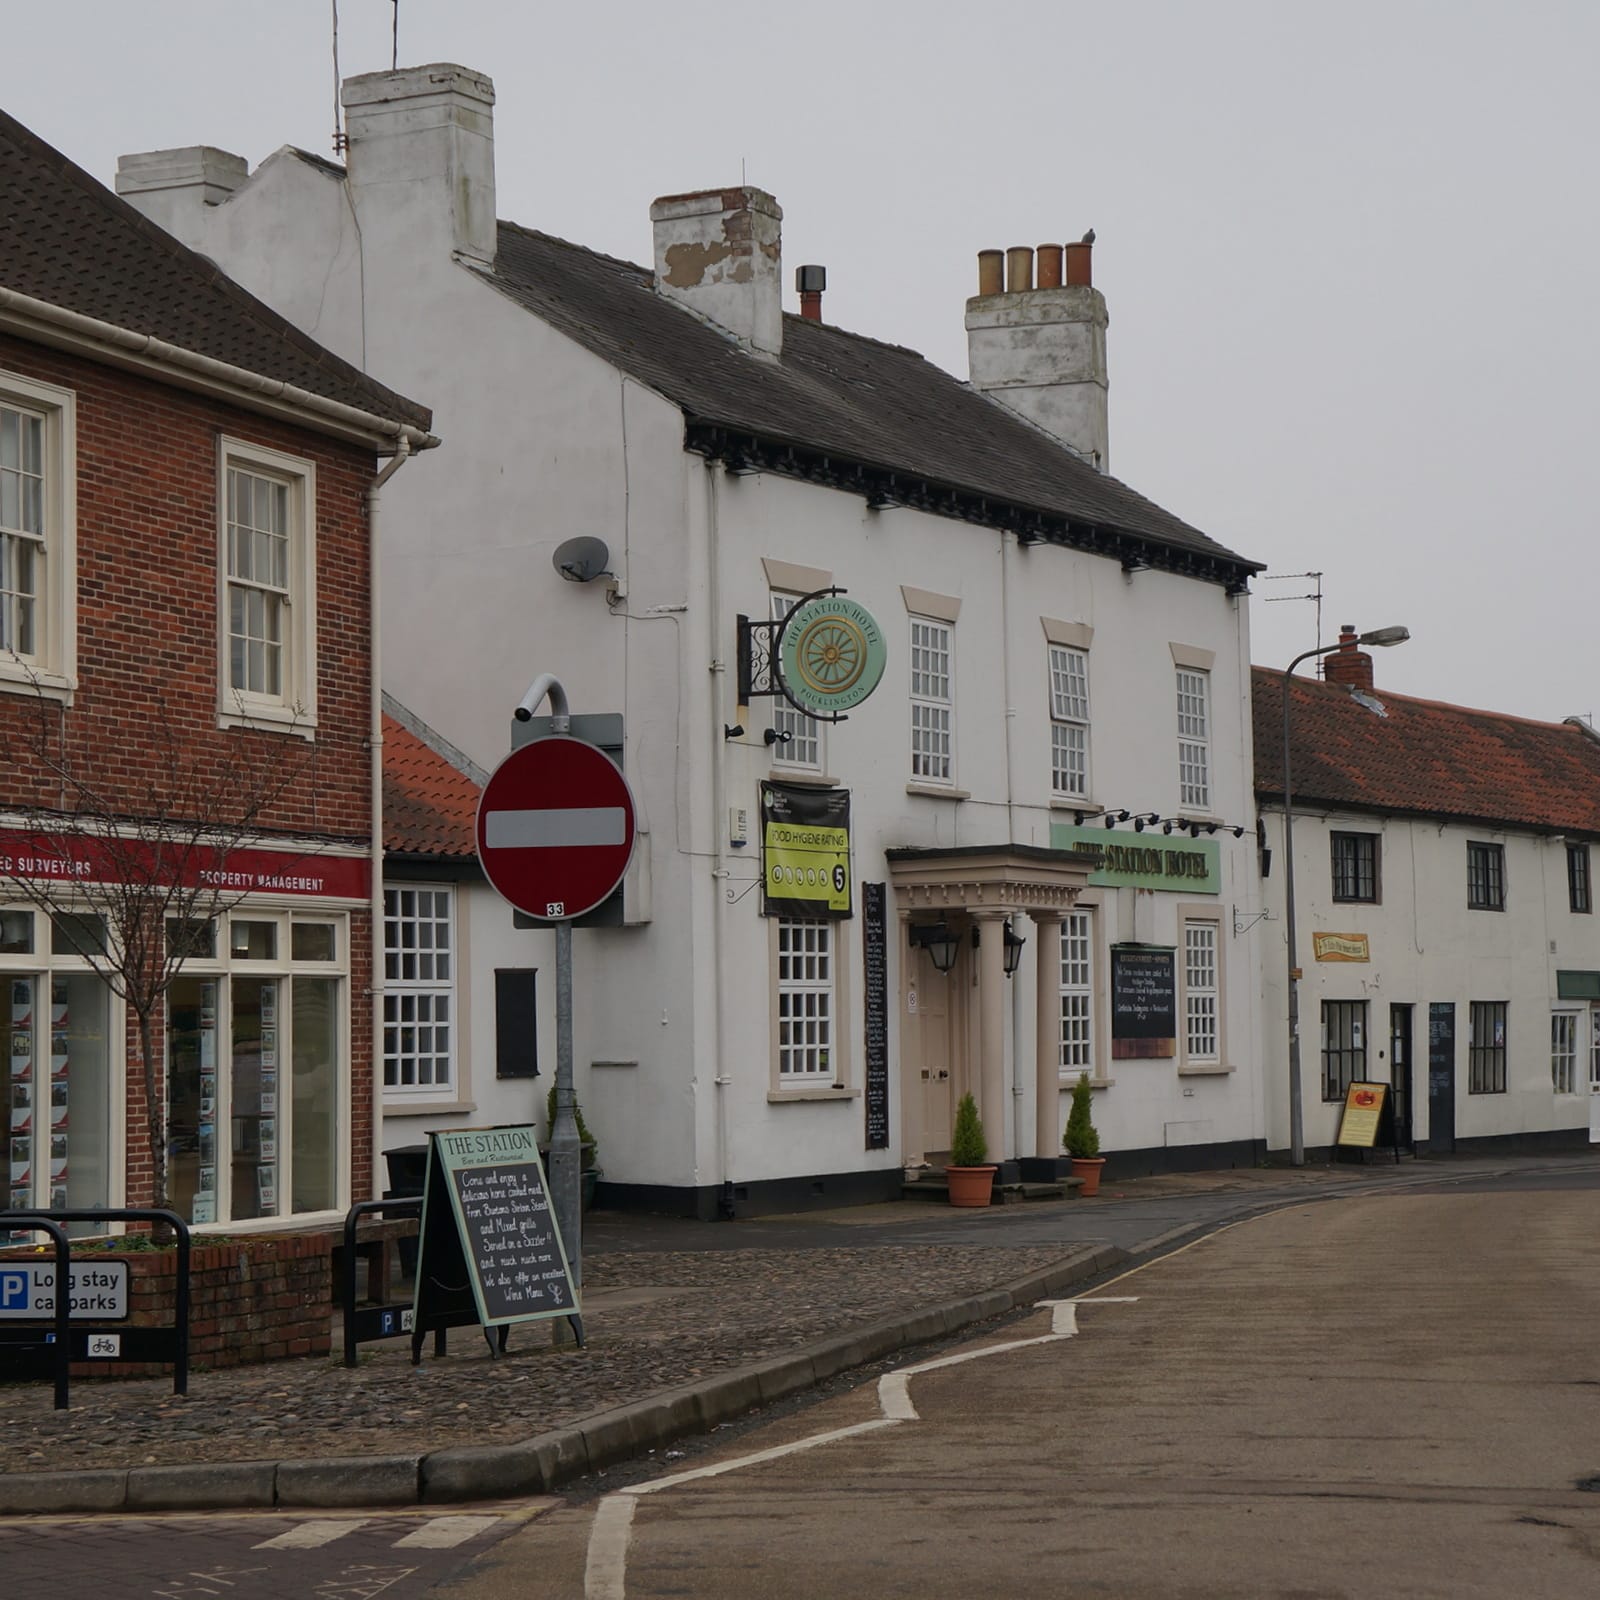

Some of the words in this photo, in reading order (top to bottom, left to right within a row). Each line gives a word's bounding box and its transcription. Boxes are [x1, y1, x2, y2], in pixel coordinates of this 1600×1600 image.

[788, 626, 802, 648] THE
[802, 601, 850, 625] STATION
[851, 608, 879, 646] HOTEL
[18, 857, 92, 875] SURVEYORS
[1105, 844, 1164, 874] STATION
[1165, 849, 1209, 879] HOTEL
[257, 874, 324, 892] MANAGEMENT
[836, 868, 843, 890] 5
[548, 904, 563, 915] 33
[445, 1137, 474, 1156] THE
[475, 1132, 533, 1154] STATION
[462, 1171, 483, 1187] Come
[485, 1170, 498, 1185] and
[500, 1175, 517, 1187] enjoy
[461, 1189, 490, 1202] delicious
[490, 1187, 506, 1199] home
[480, 1219, 495, 1235] and
[496, 1217, 518, 1232] Mixed
[483, 1236, 507, 1252] Served
[507, 1241, 516, 1249] on
[516, 1240, 522, 1248] a
[480, 1256, 495, 1269] and
[500, 1255, 517, 1266] much
[520, 1252, 537, 1264] much
[34, 1271, 75, 1289] Log
[82, 1271, 118, 1289] stay
[484, 1273, 495, 1287] We
[498, 1272, 511, 1285] also
[3, 1275, 24, 1306] P
[525, 1285, 544, 1299] Menu
[68, 1294, 117, 1313] parks
[384, 1314, 392, 1333] P
